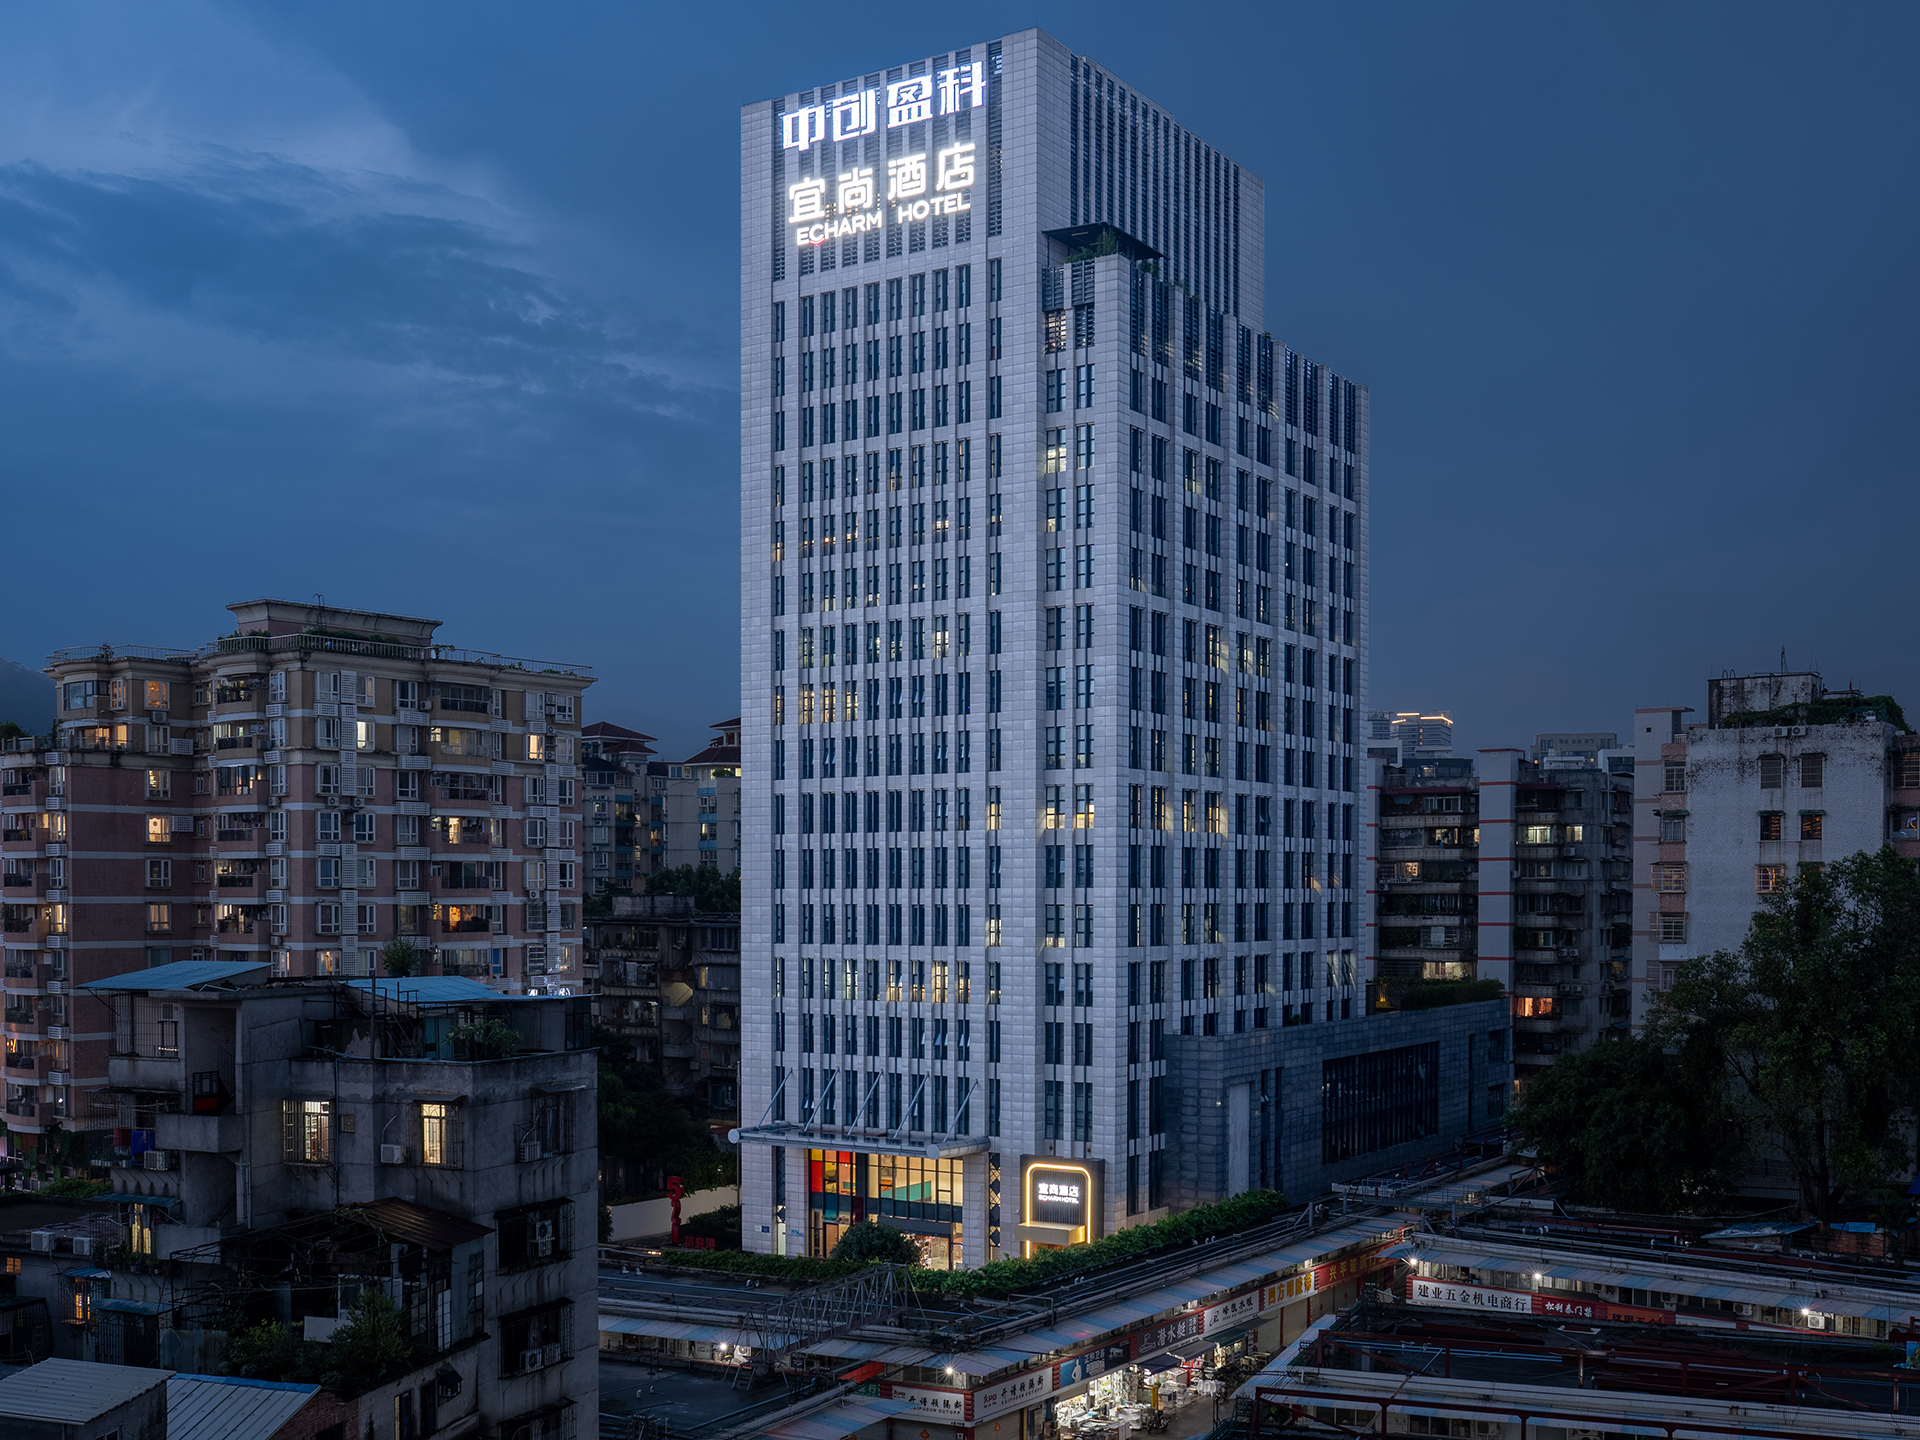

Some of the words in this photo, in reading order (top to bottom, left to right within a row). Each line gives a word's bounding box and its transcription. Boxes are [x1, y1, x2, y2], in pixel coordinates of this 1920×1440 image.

[783, 61, 986, 151] 中创盈科
[788, 142, 976, 223] 宜尚酒店
[796, 211, 883, 245] ECHARM
[898, 193, 971, 224] HOTEL
[1038, 1183, 1079, 1197] 宜尚酒店
[1061, 1196, 1079, 1204] HOTEL
[1417, 1284, 1527, 1312] 建业五金机电商行
[1157, 1322, 1186, 1346] 潜水艇
[1025, 1387, 1043, 1396] CUTOFF
